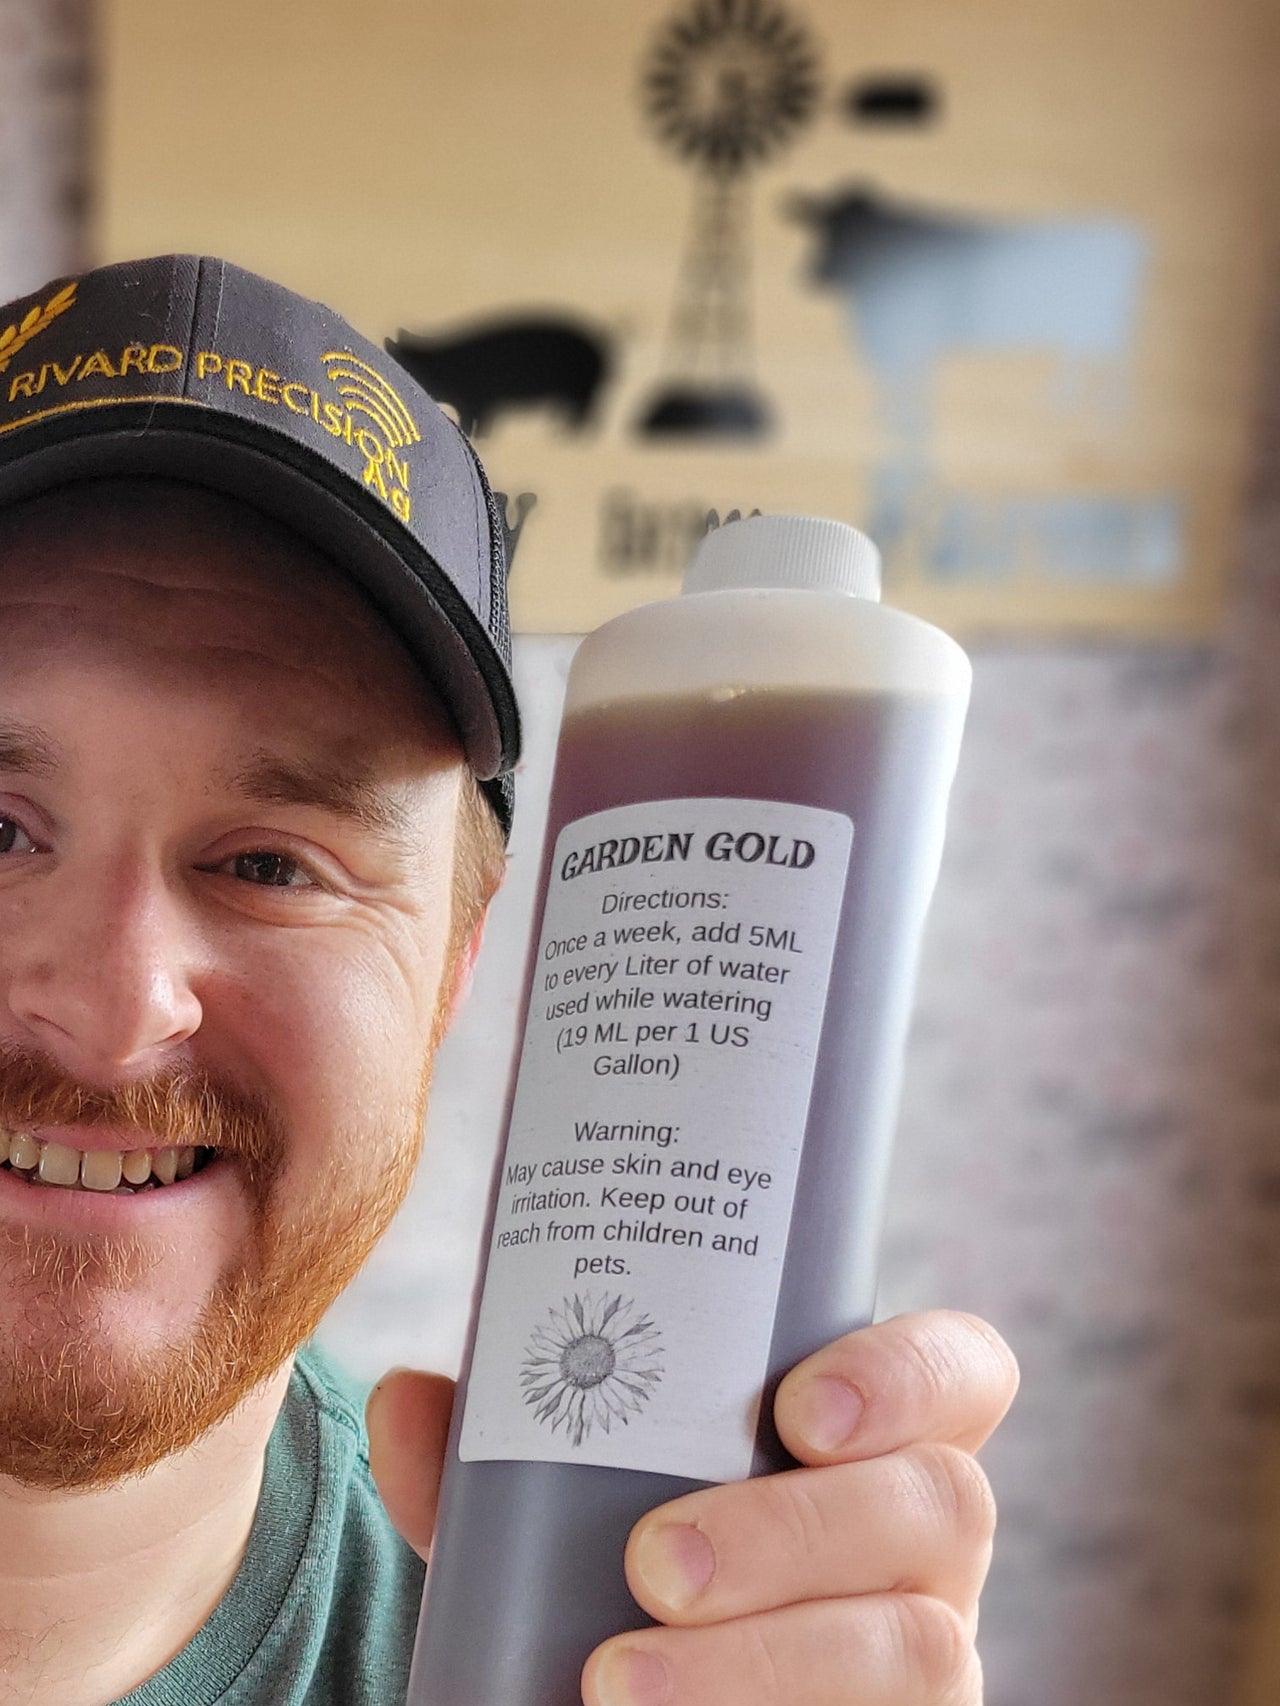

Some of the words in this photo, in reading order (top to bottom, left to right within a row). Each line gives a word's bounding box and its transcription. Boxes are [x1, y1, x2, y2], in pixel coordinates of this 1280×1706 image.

[9, 344, 183, 402] RIVARD
[196, 351, 410, 492] PRECISION
[561, 833, 694, 881] GARDEN
[705, 832, 815, 869] GOLD
[602, 890, 729, 914] Directions:
[545, 935, 587, 960] Once
[594, 932, 606, 947] a
[614, 920, 680, 944] week,
[692, 922, 741, 943] add
[749, 926, 802, 953] 5ML
[545, 973, 558, 991] to
[564, 962, 618, 985] every
[626, 956, 679, 975] Liter
[687, 955, 713, 975] of
[719, 961, 790, 984] water
[546, 992, 590, 1020] used
[596, 987, 654, 1011] while
[663, 990, 772, 1021] watering
[557, 1026, 587, 1053] (19
[595, 1022, 628, 1043] ML
[636, 1025, 678, 1047] per
[685, 1022, 699, 1043] 1
[711, 1024, 749, 1047] US
[594, 1053, 679, 1080] Gallon)
[575, 1120, 680, 1147] Warning:
[506, 1164, 537, 1185] May
[542, 1159, 604, 1177] cause
[612, 1153, 661, 1175] skin
[671, 1159, 719, 1181] and
[728, 1168, 771, 1191] eye
[512, 1188, 590, 1214] irritation.
[601, 1187, 665, 1214] Keep
[675, 1196, 715, 1215] out
[723, 1199, 748, 1219] of
[497, 1222, 540, 1248] reach
[547, 1220, 595, 1241] from
[604, 1219, 702, 1247] children
[712, 1234, 758, 1256] and
[574, 1255, 630, 1279] pets.
